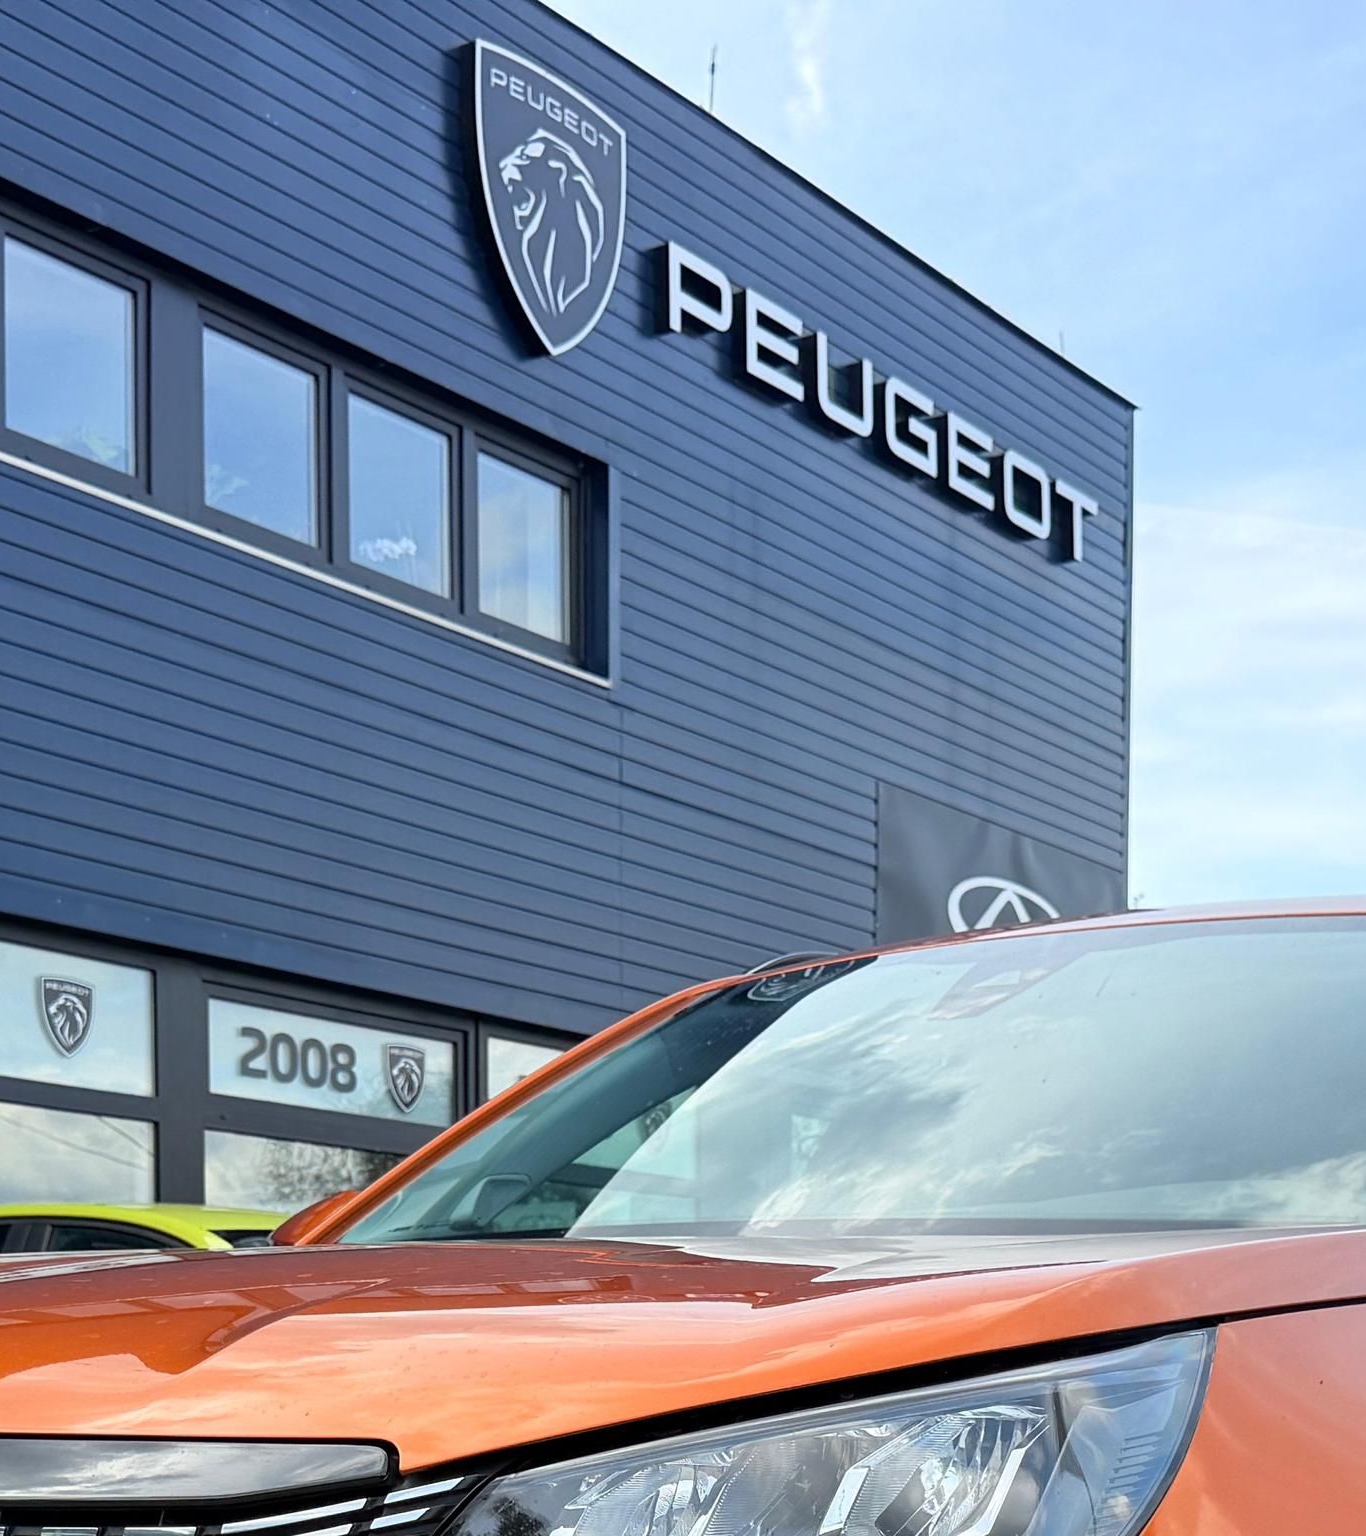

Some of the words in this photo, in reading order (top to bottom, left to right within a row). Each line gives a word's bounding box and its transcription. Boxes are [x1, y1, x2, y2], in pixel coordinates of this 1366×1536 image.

[490, 68, 613, 156] PEUGEOT
[667, 241, 1099, 562] PEUGEOT
[46, 982, 89, 996] PEUGEOT
[240, 1027, 357, 1093] 2008
